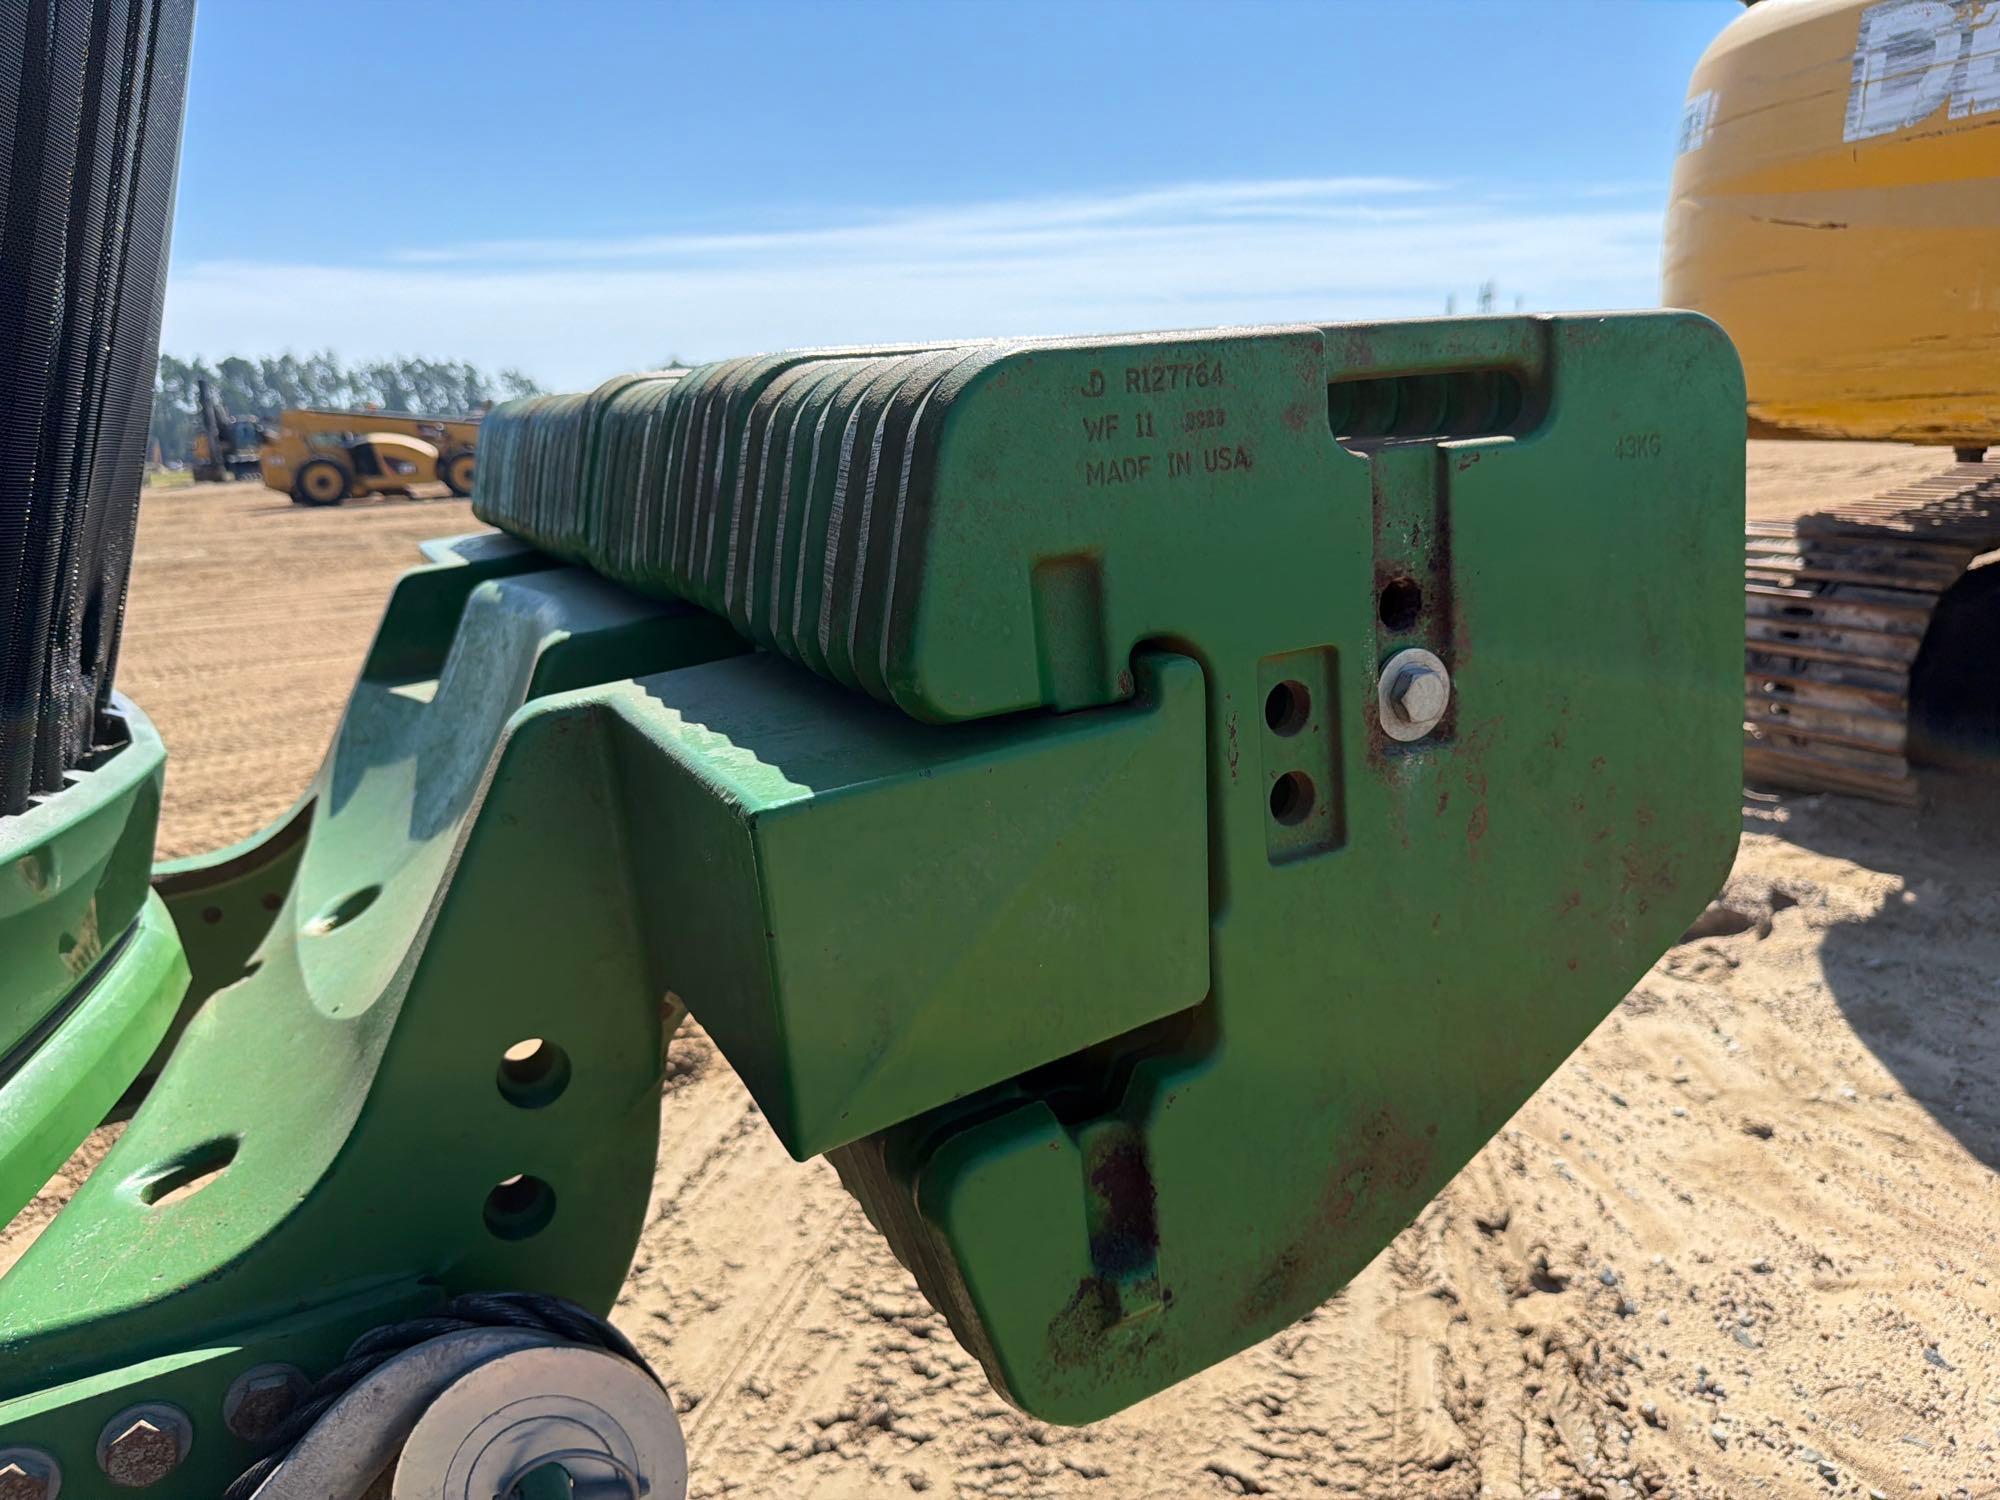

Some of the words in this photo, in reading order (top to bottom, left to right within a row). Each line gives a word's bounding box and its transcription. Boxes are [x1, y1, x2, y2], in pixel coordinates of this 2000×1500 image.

[1125, 360, 1224, 393] R127764
[1082, 414, 1119, 442] WF
[1166, 451, 1192, 478] IN
[1204, 445, 1251, 473] USA
